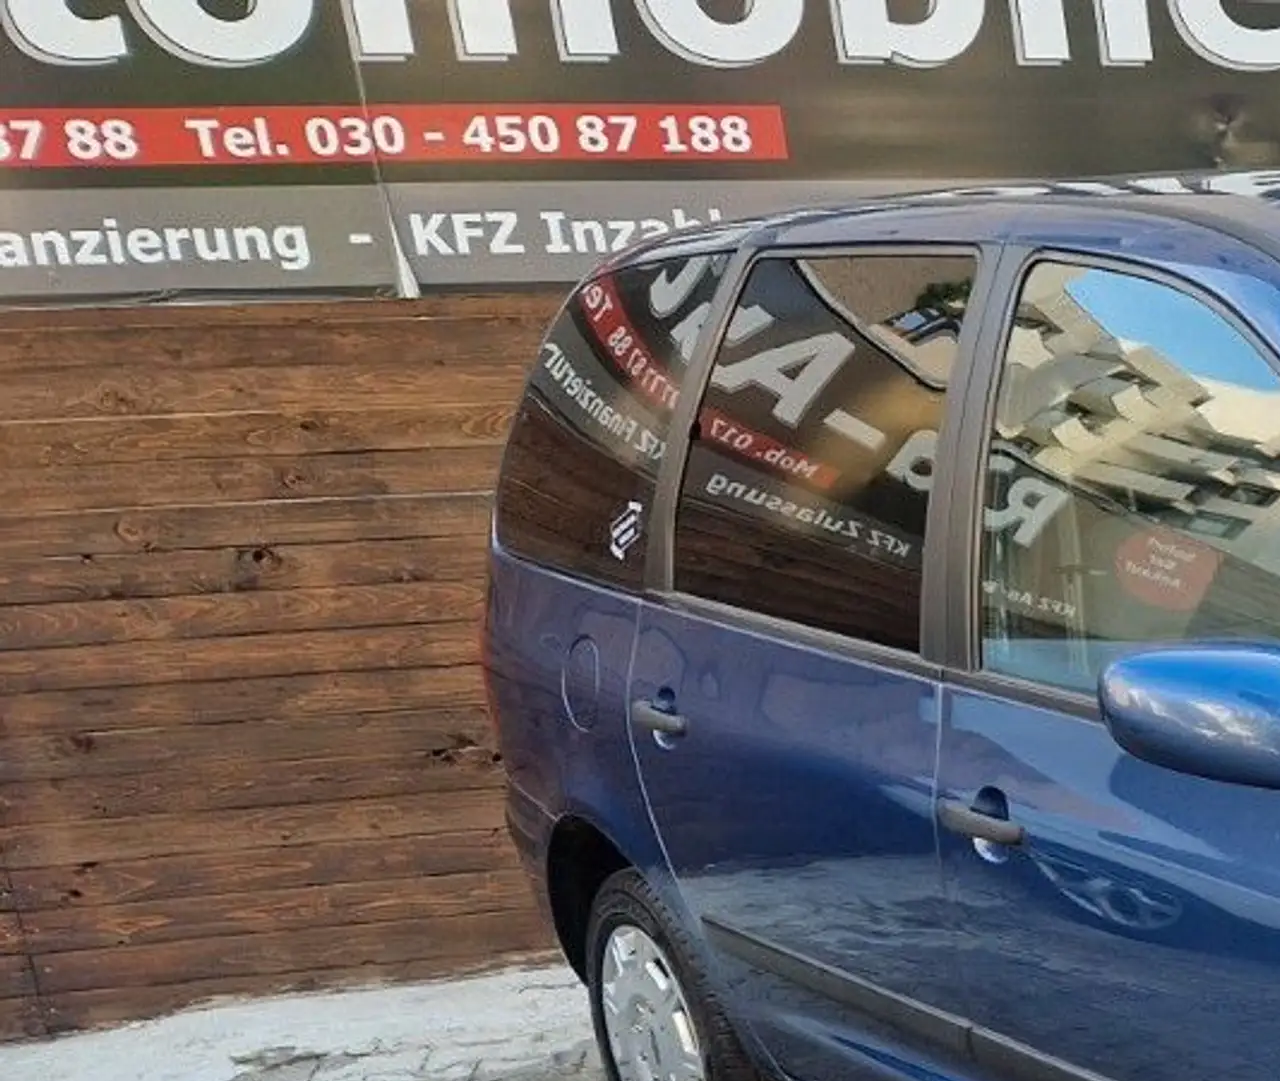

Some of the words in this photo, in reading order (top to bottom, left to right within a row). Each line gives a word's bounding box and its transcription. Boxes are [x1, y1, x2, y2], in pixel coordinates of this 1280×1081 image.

[64, 118, 139, 160] 88
[184, 116, 290, 158] Tel.
[304, 115, 405, 157] 030
[462, 114, 561, 153] 450
[576, 114, 638, 153] 87
[658, 114, 752, 152] 188
[408, 211, 526, 256] KFZ
